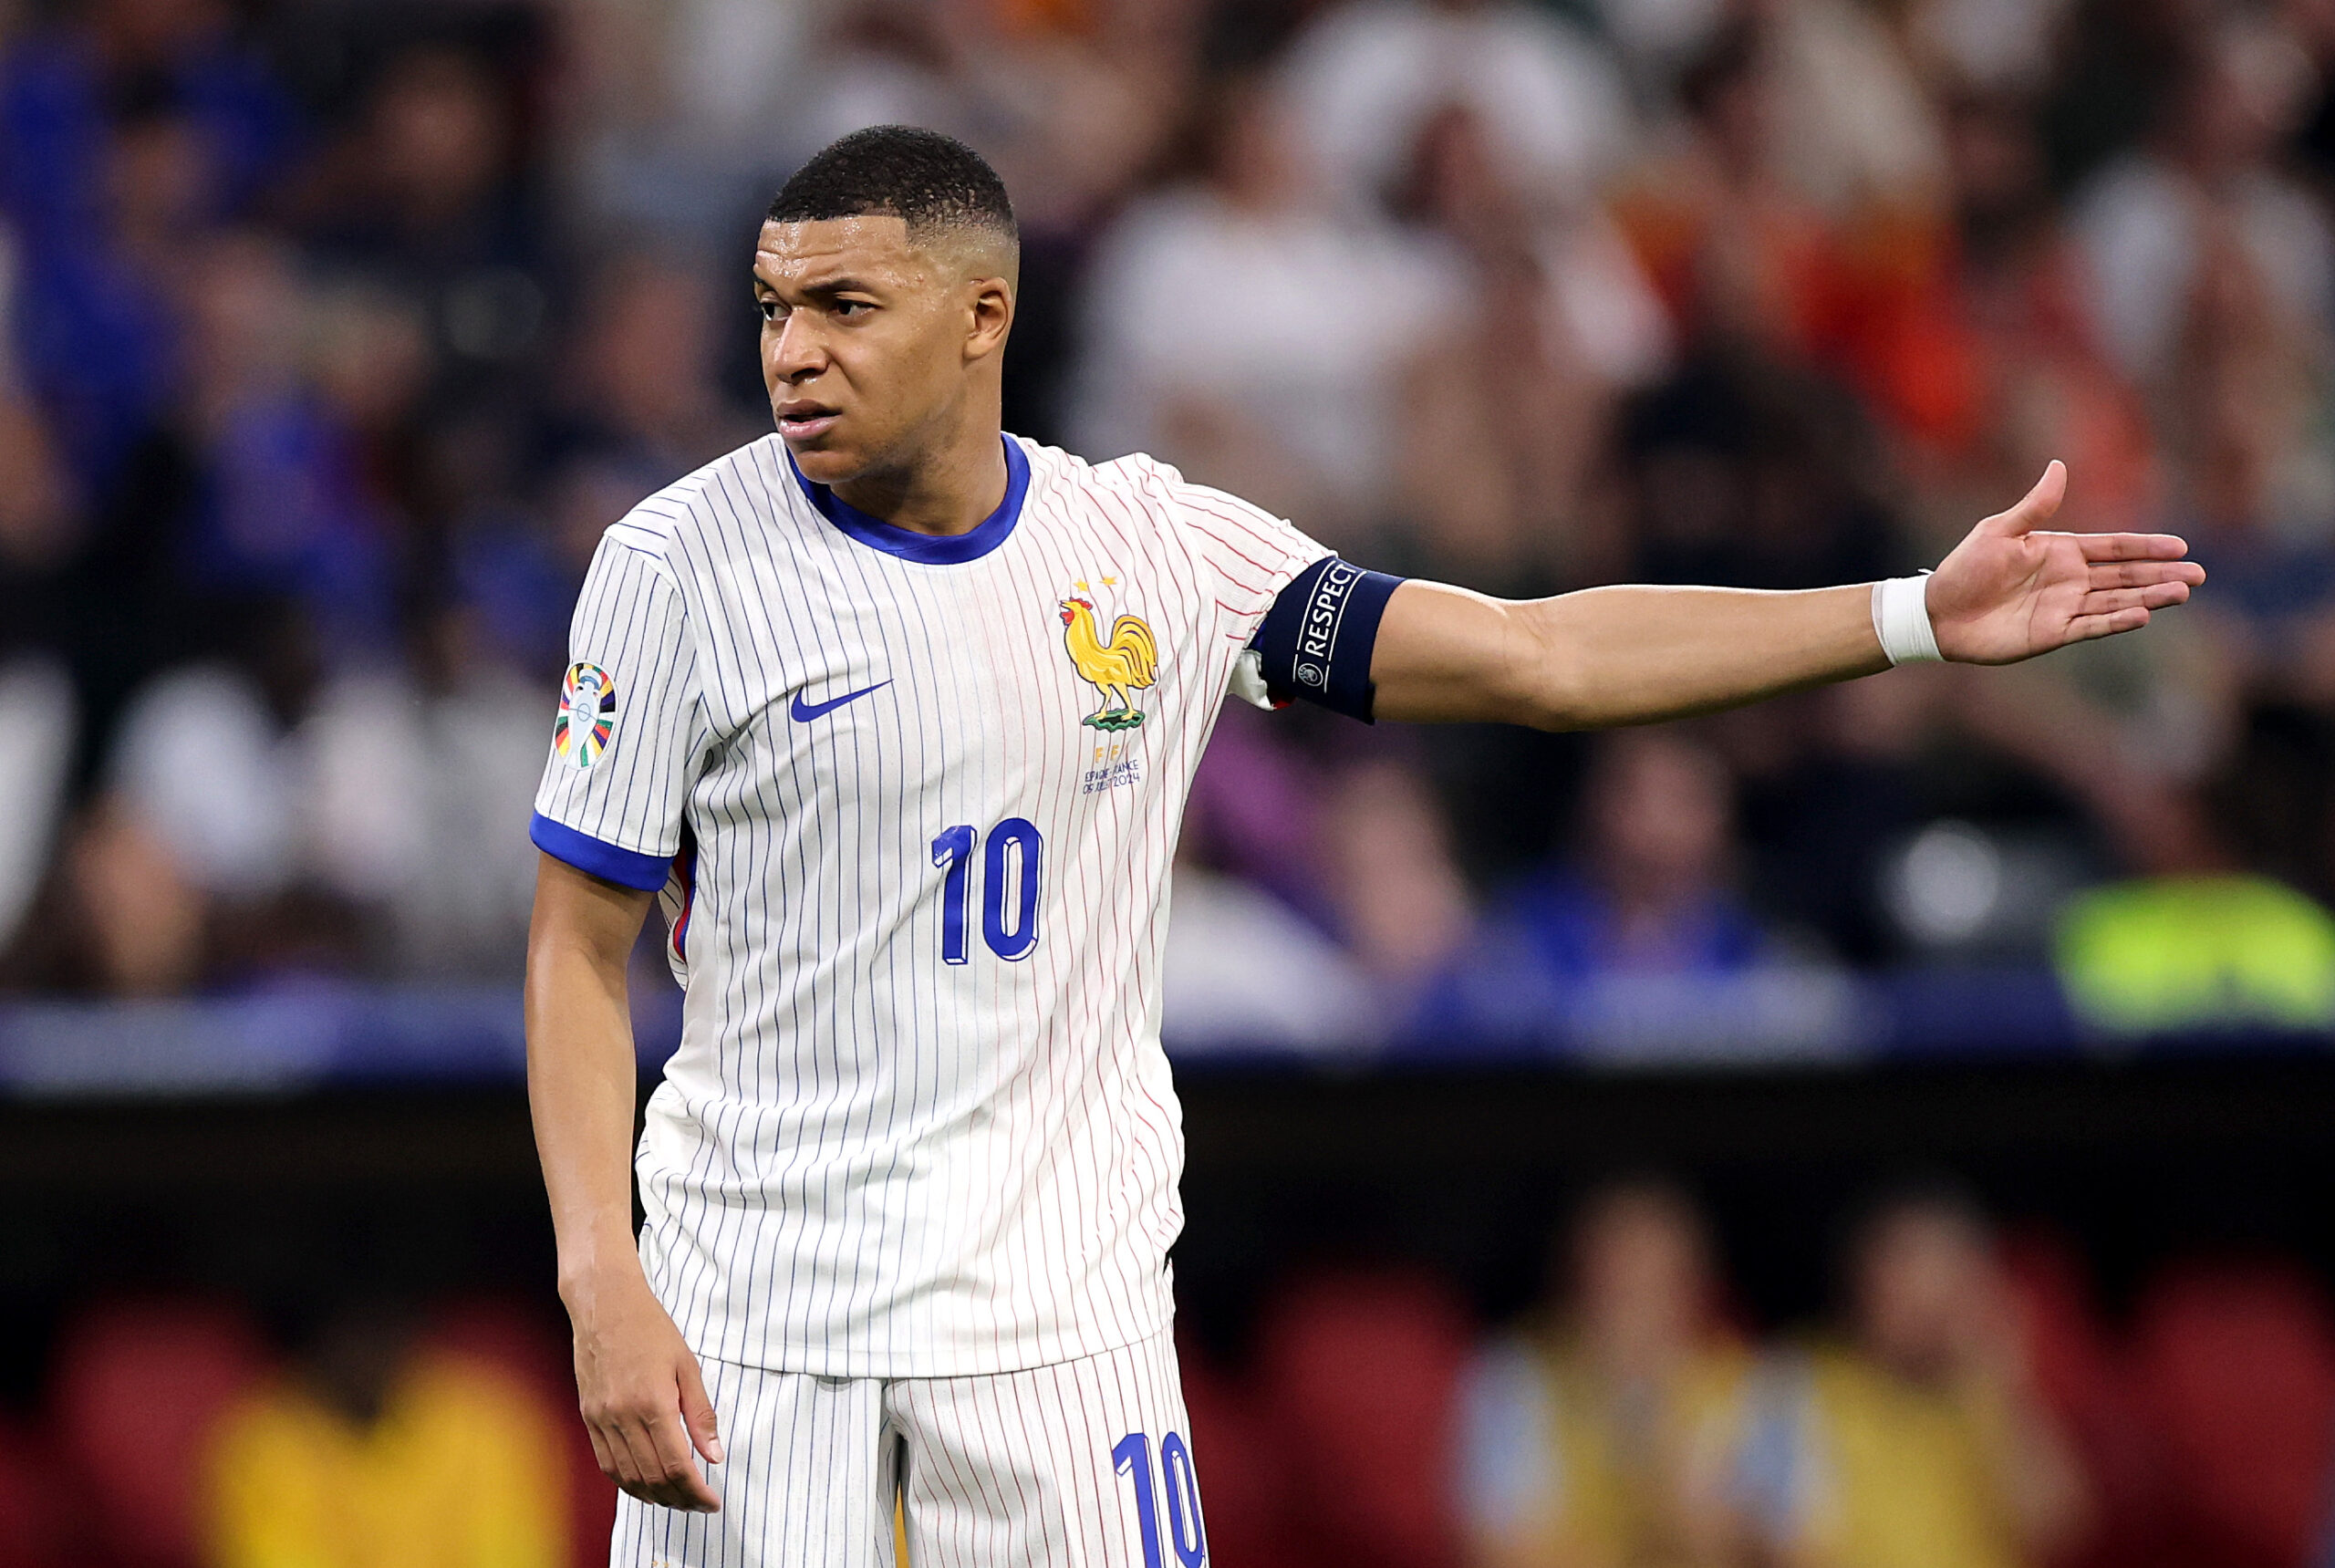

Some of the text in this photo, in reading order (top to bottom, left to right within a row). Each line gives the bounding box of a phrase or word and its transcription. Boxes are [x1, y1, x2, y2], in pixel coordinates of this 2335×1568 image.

[1305, 563, 1356, 658] RESPECT
[1113, 773, 1140, 786] 2024
[931, 817, 1044, 965] 10
[1111, 1431, 1207, 1568] 10
